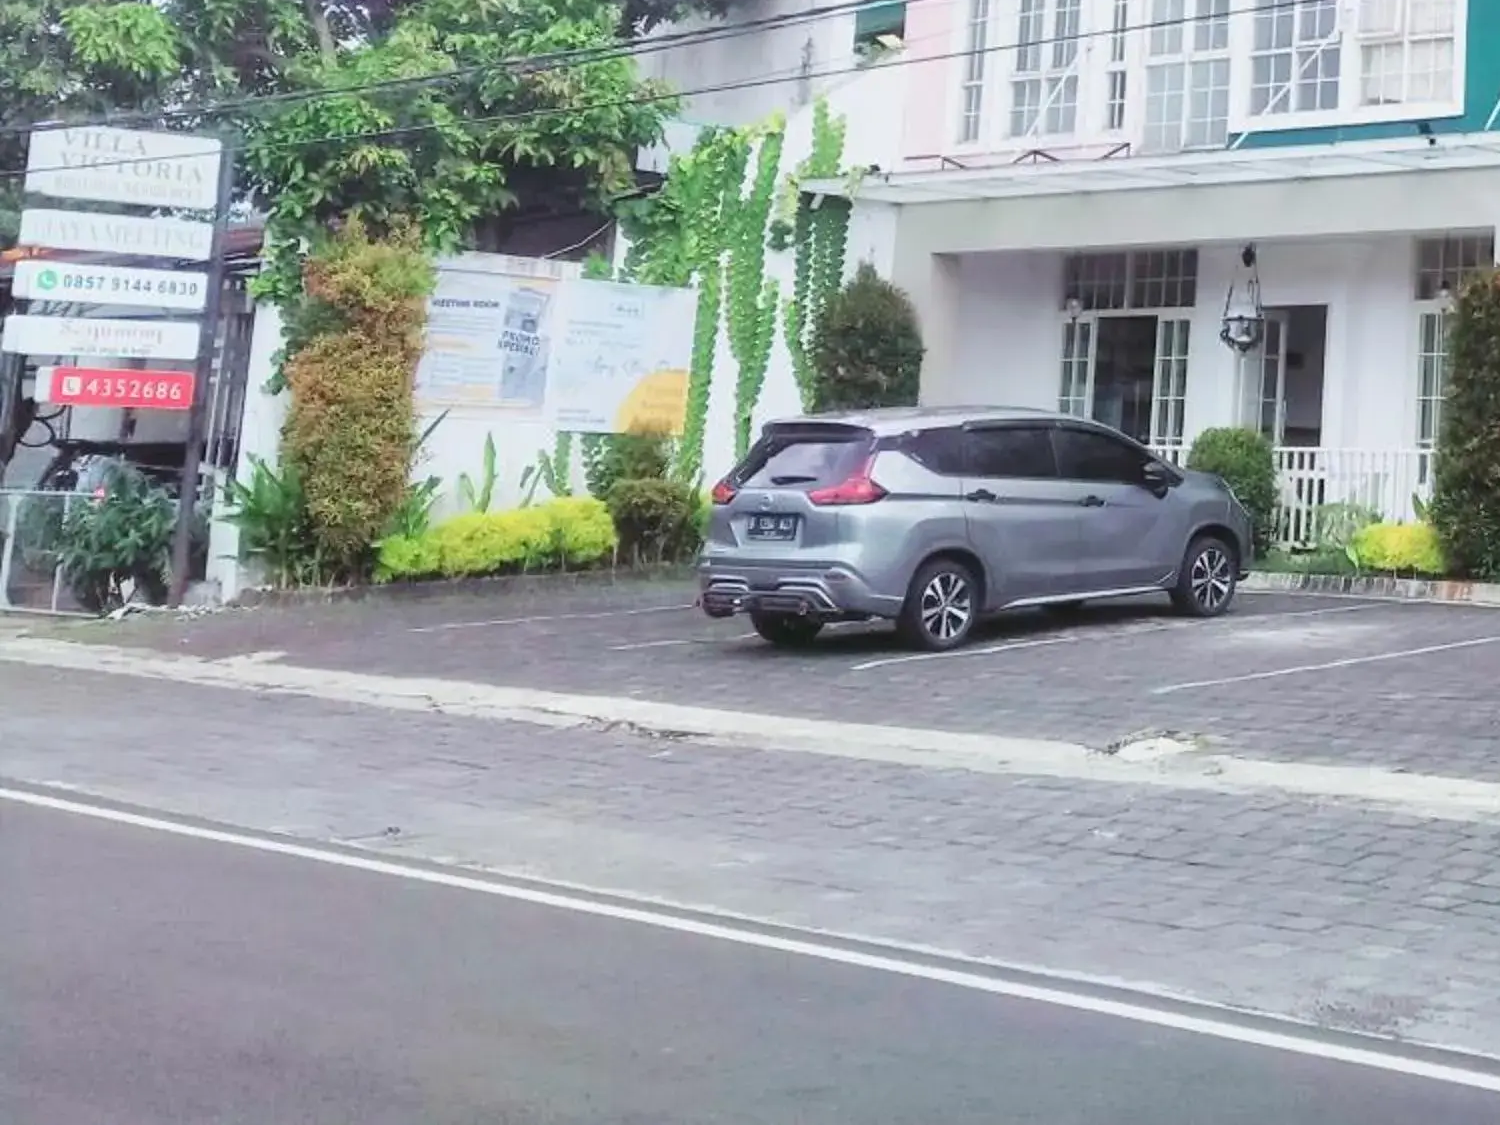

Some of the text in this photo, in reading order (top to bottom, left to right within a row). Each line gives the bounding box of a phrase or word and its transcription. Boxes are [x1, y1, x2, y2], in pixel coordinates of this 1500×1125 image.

[64, 129, 147, 156] VILLA
[61, 151, 204, 183] VICTORIA
[63, 273, 107, 289] 0857
[111, 277, 152, 292] 9144
[86, 376, 182, 400] 4352686
